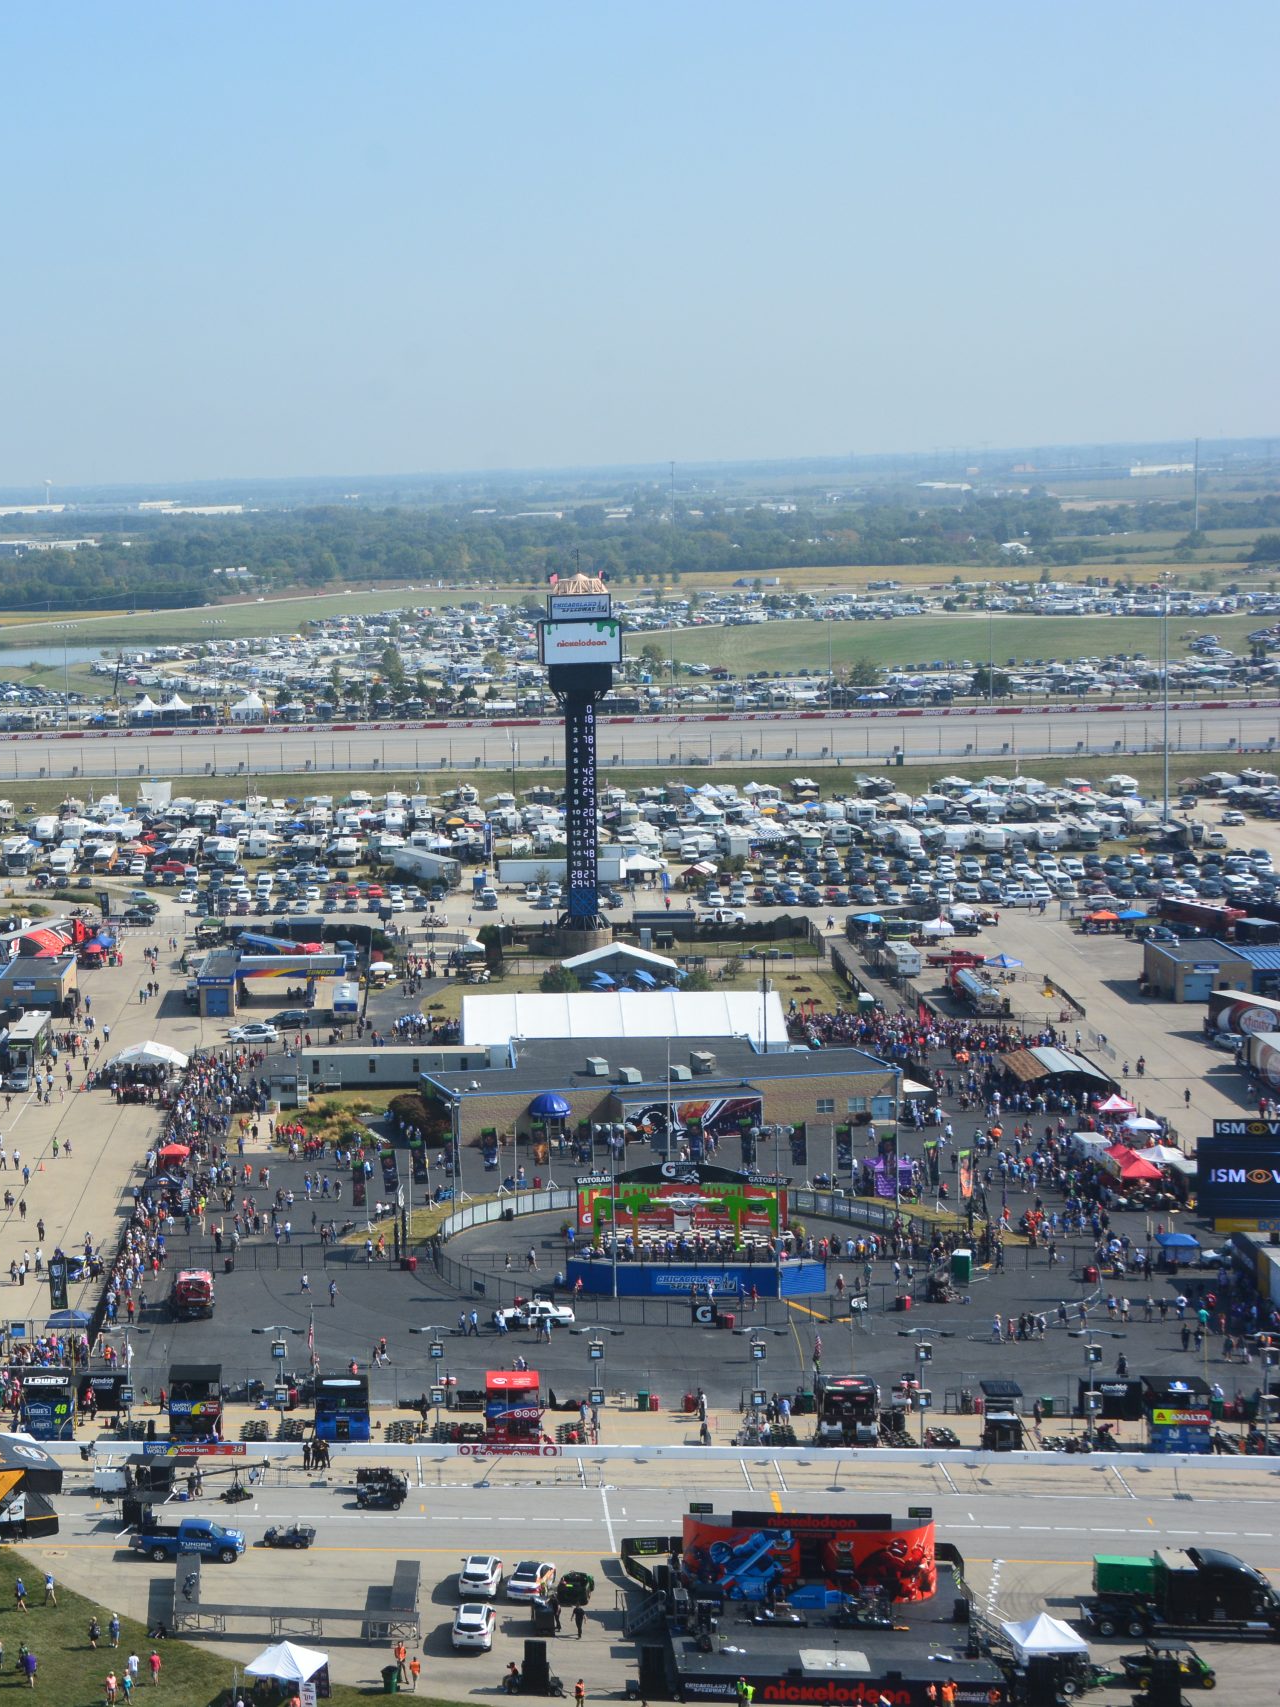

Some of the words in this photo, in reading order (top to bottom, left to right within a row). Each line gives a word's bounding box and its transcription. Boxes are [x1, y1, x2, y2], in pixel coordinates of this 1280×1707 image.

[556, 639, 607, 648] nickelodeon
[585, 715, 594, 724] 18
[583, 736, 594, 744] 78
[582, 788, 594, 796] 24
[589, 798, 594, 806] 3
[583, 829, 595, 837] 21
[583, 850, 595, 858] 48
[586, 859, 595, 867] 17
[571, 880, 583, 888] 29
[584, 880, 595, 888] 47
[1216, 1122, 1246, 1134] ISM
[1210, 1169, 1246, 1183] ISM
[656, 1275, 722, 1285] CHICAGOLAND
[696, 1306, 711, 1322] G
[54, 1404, 68, 1415] 48
[768, 1516, 858, 1528] nickelodeon
[764, 1680, 911, 1704] nickelodeon
